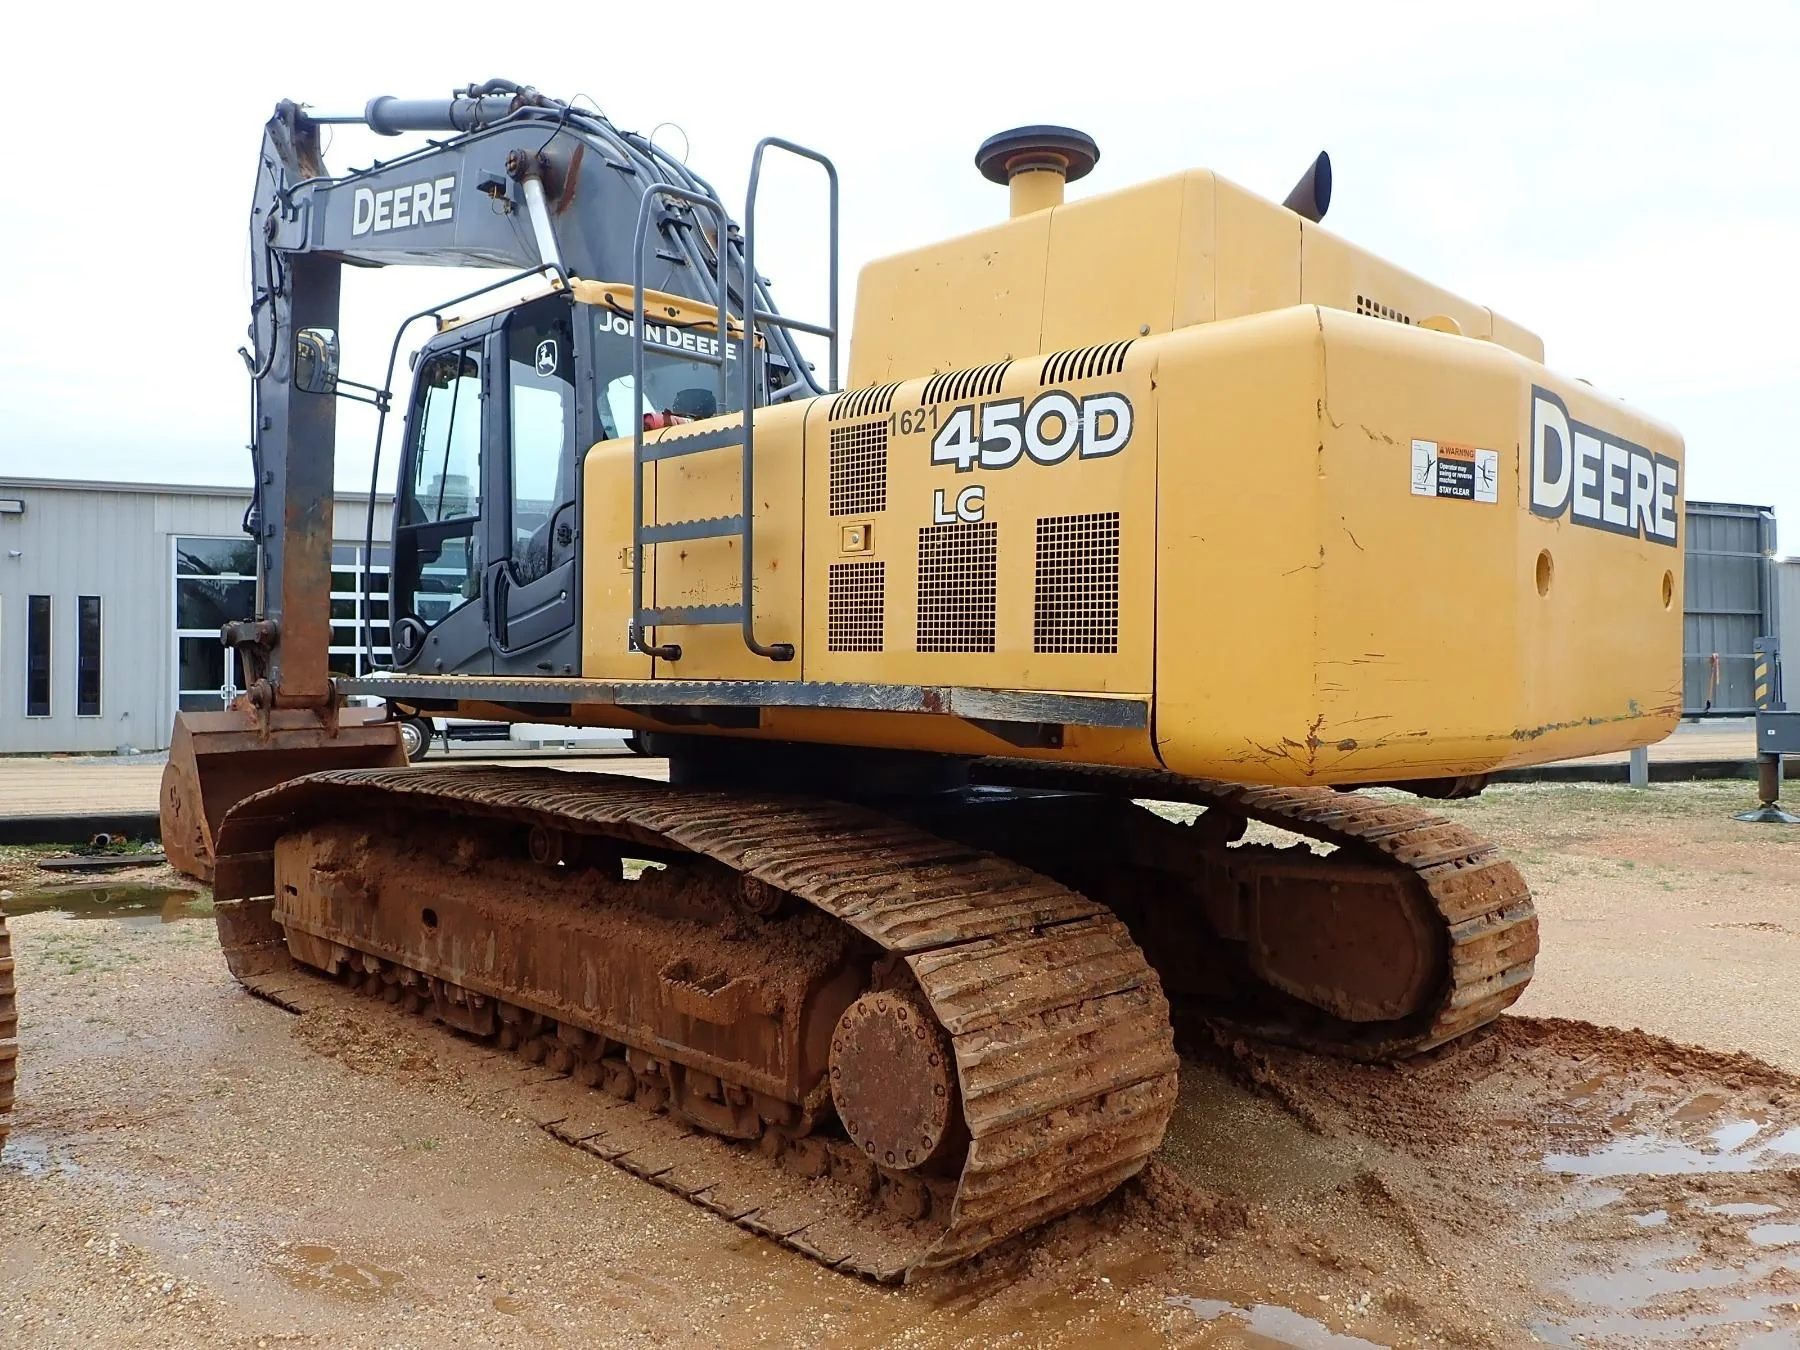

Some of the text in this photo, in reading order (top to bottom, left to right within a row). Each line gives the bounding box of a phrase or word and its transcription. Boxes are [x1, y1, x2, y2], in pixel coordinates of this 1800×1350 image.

[352, 175, 456, 236] DEERE
[887, 404, 938, 437] 1621
[932, 390, 1133, 472] 450D
[1445, 446, 1474, 458] WARNING
[1531, 392, 1678, 541] DEERE
[934, 485, 985, 525] LC
[1439, 485, 1470, 496] STAY CLEAR
